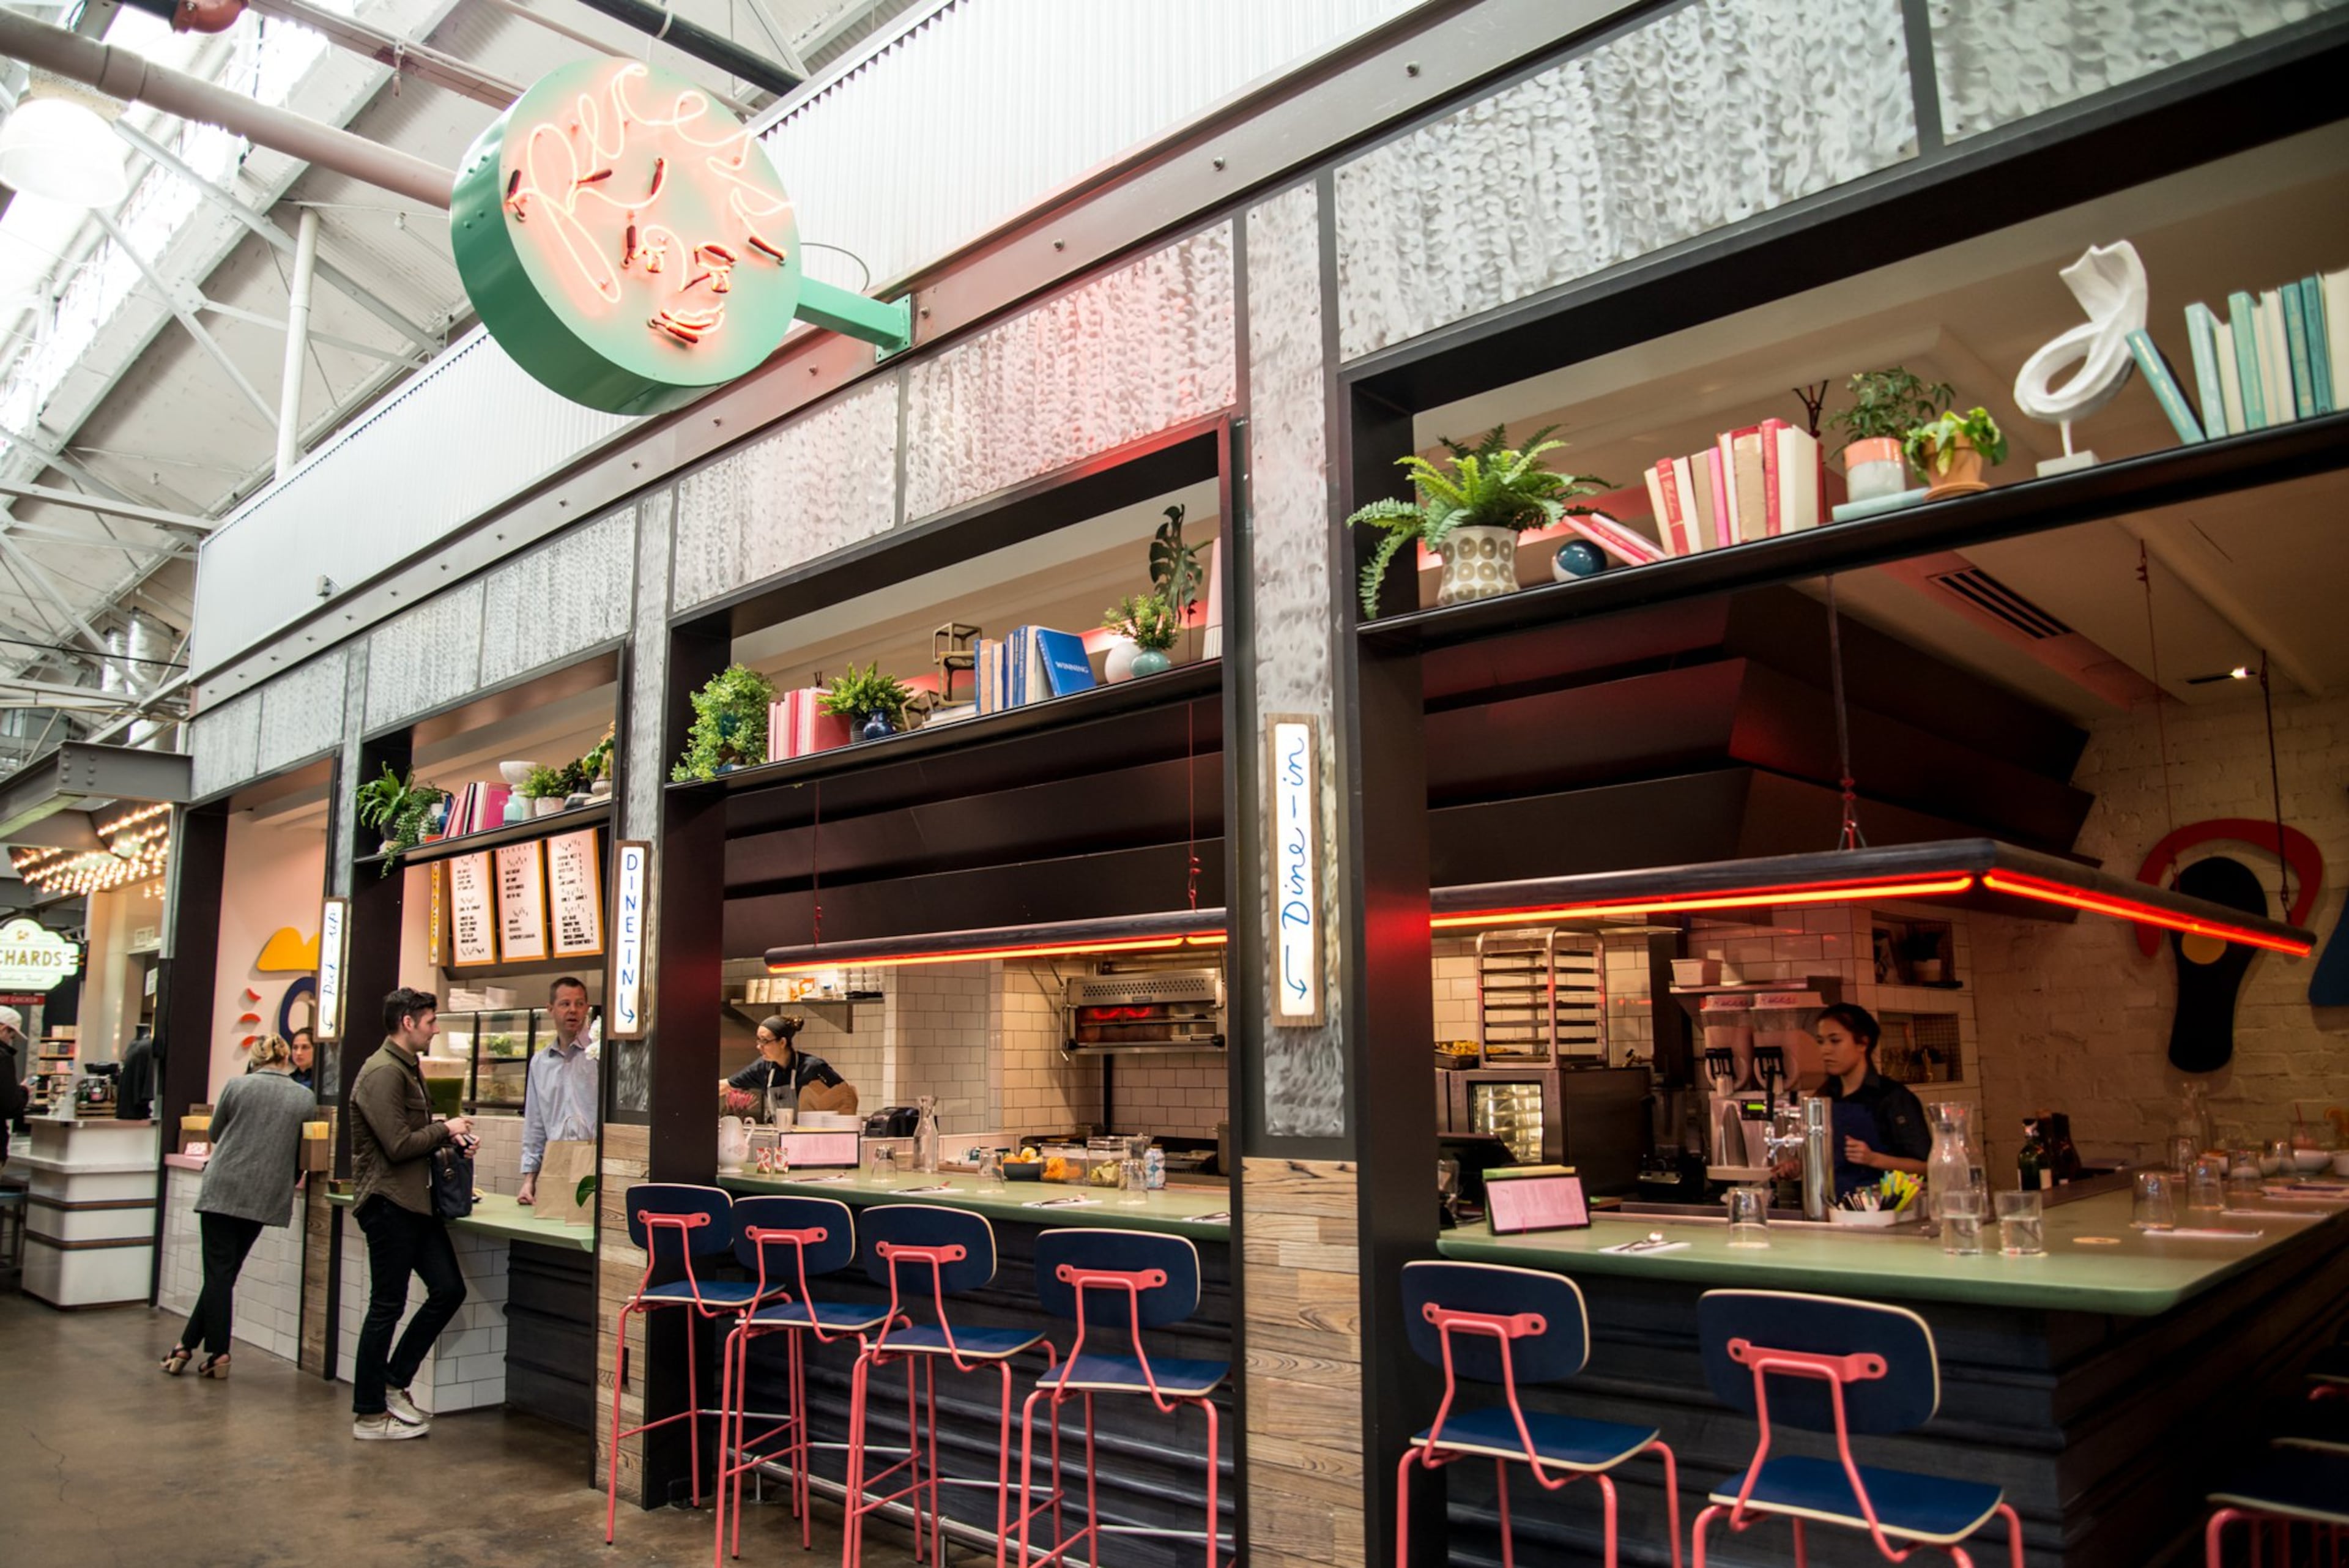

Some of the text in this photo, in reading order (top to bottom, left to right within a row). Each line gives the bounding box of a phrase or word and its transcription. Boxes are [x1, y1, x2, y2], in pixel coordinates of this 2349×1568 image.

[1055, 661, 1089, 674] WINNING
[1282, 737, 1310, 930] Dine-in
[621, 853, 638, 986] DINE-IN
